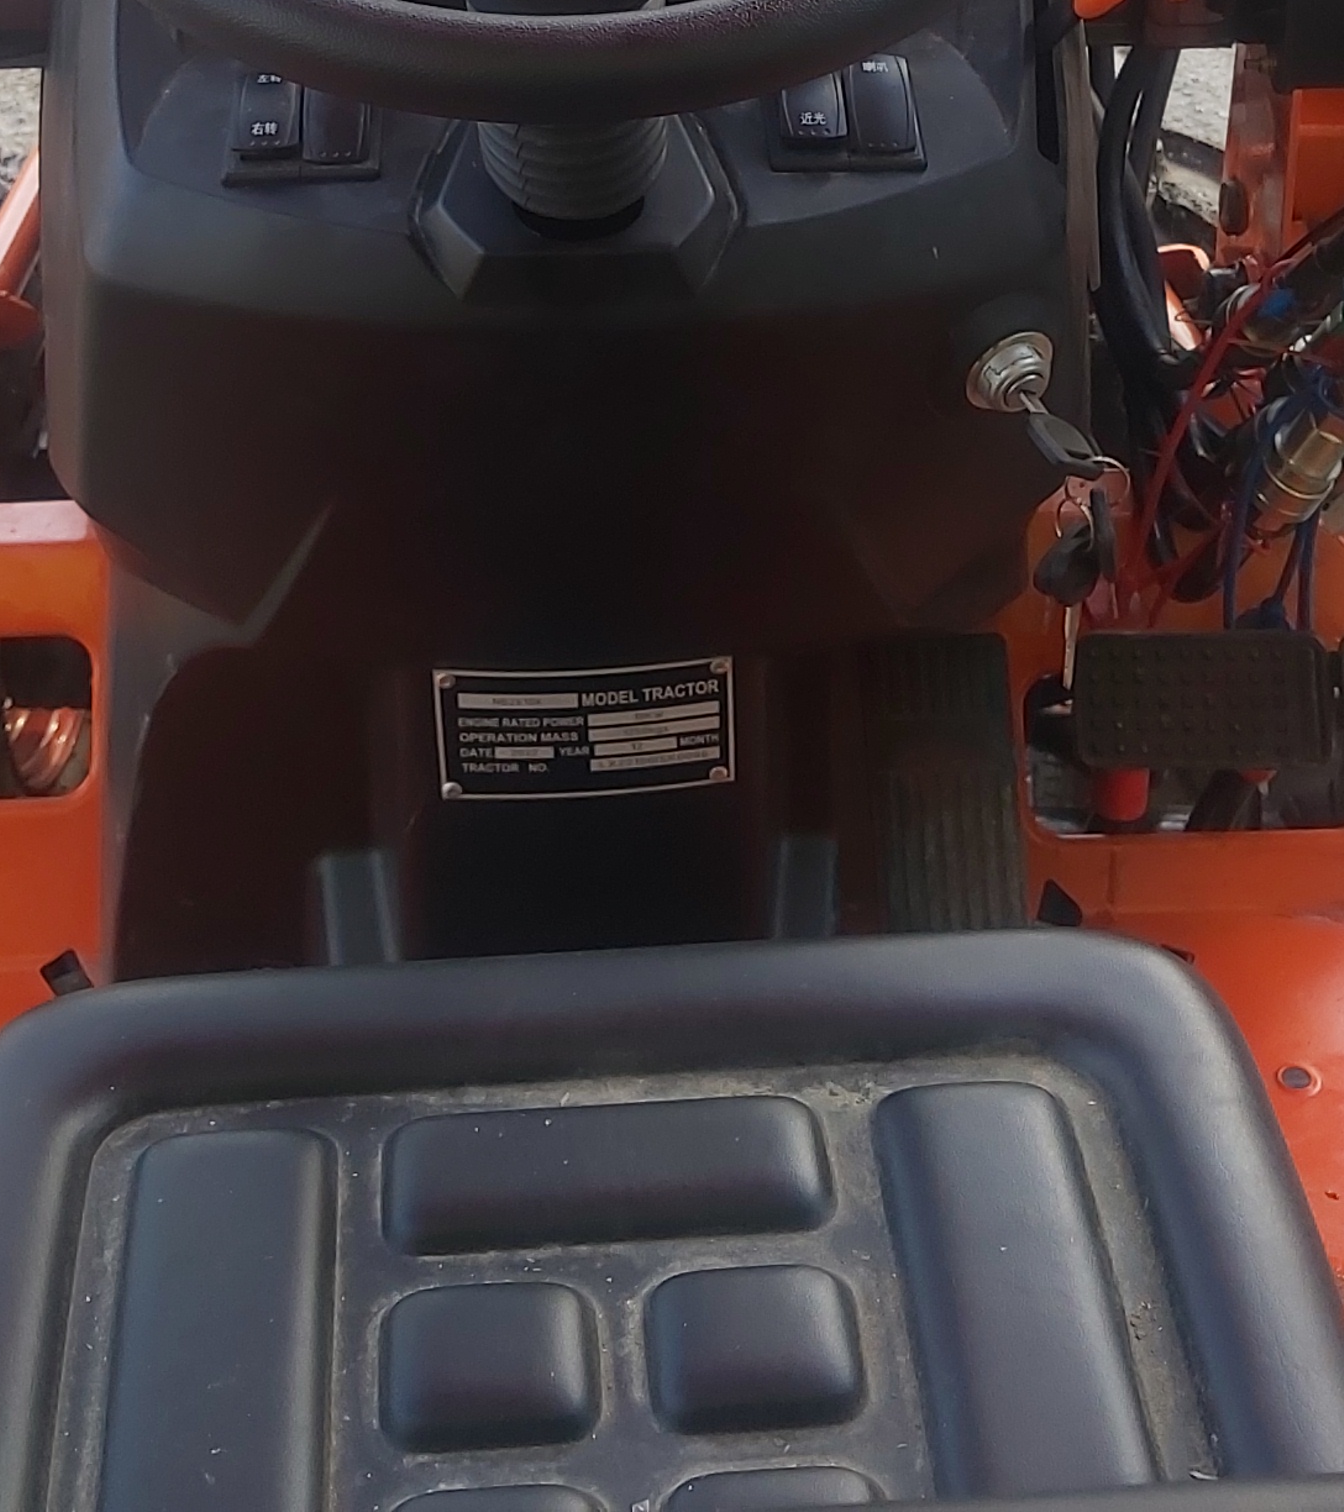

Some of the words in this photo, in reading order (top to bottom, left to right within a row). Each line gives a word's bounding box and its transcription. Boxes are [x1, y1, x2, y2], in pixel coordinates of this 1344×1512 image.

[800, 111, 827, 125] 近光
[251, 122, 278, 135] 右转
[581, 690, 639, 707] MODEL
[642, 679, 719, 702] TRACTOR
[457, 717, 500, 727] ENGINE
[502, 717, 541, 727] RATED
[542, 716, 584, 727] POWER
[459, 732, 538, 743] OPERATION
[540, 731, 579, 742] MASS
[679, 734, 719, 747] MONTH
[459, 747, 493, 757] DATE
[558, 746, 590, 756] YEAR
[462, 762, 520, 773] TRACTOR
